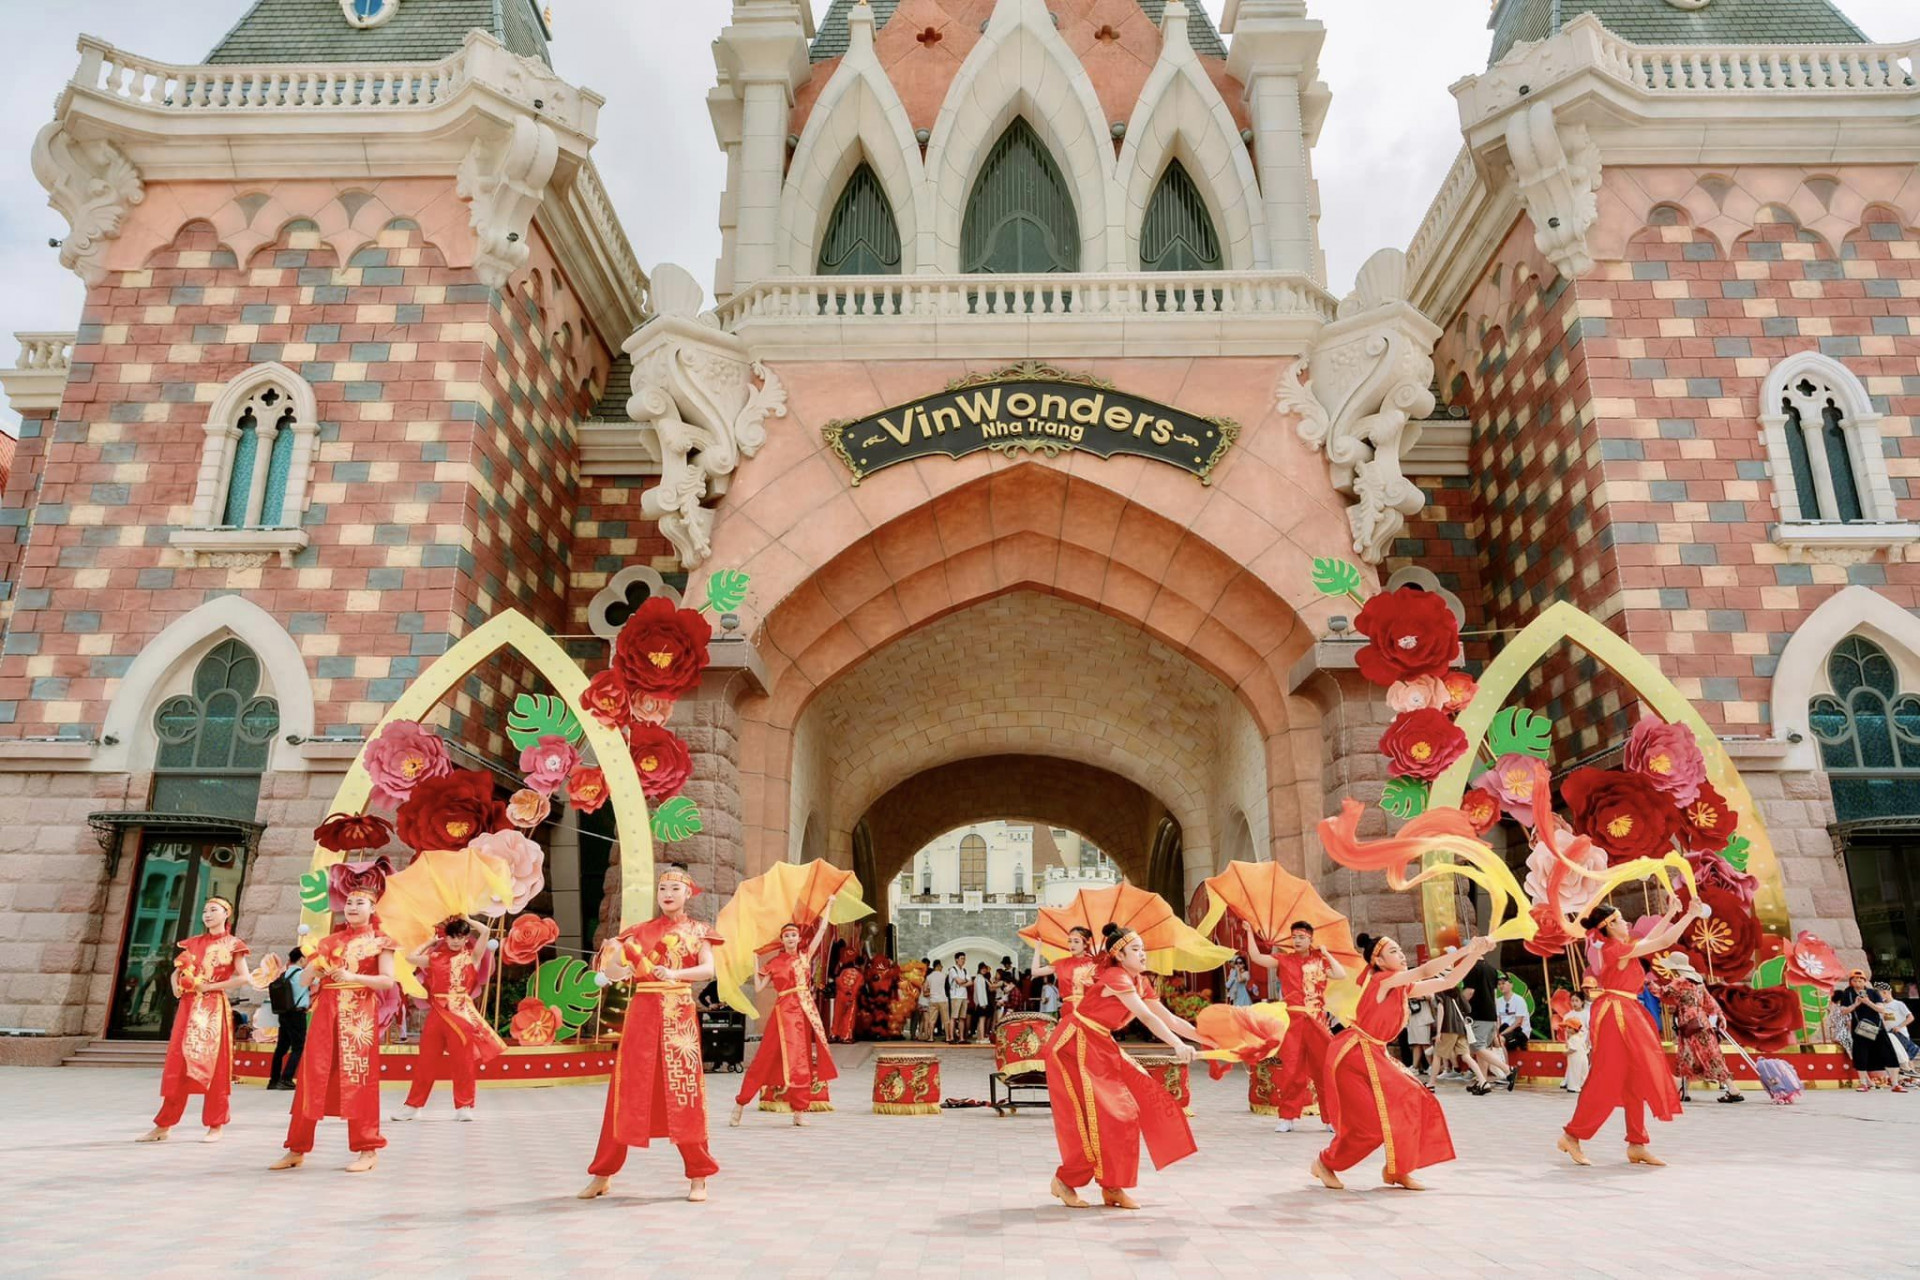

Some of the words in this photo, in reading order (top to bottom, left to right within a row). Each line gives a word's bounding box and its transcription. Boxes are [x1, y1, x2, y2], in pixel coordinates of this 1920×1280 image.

[877, 388, 1175, 446] VinWonders
[981, 421, 1022, 439] Nha
[1028, 418, 1084, 443] Trang
